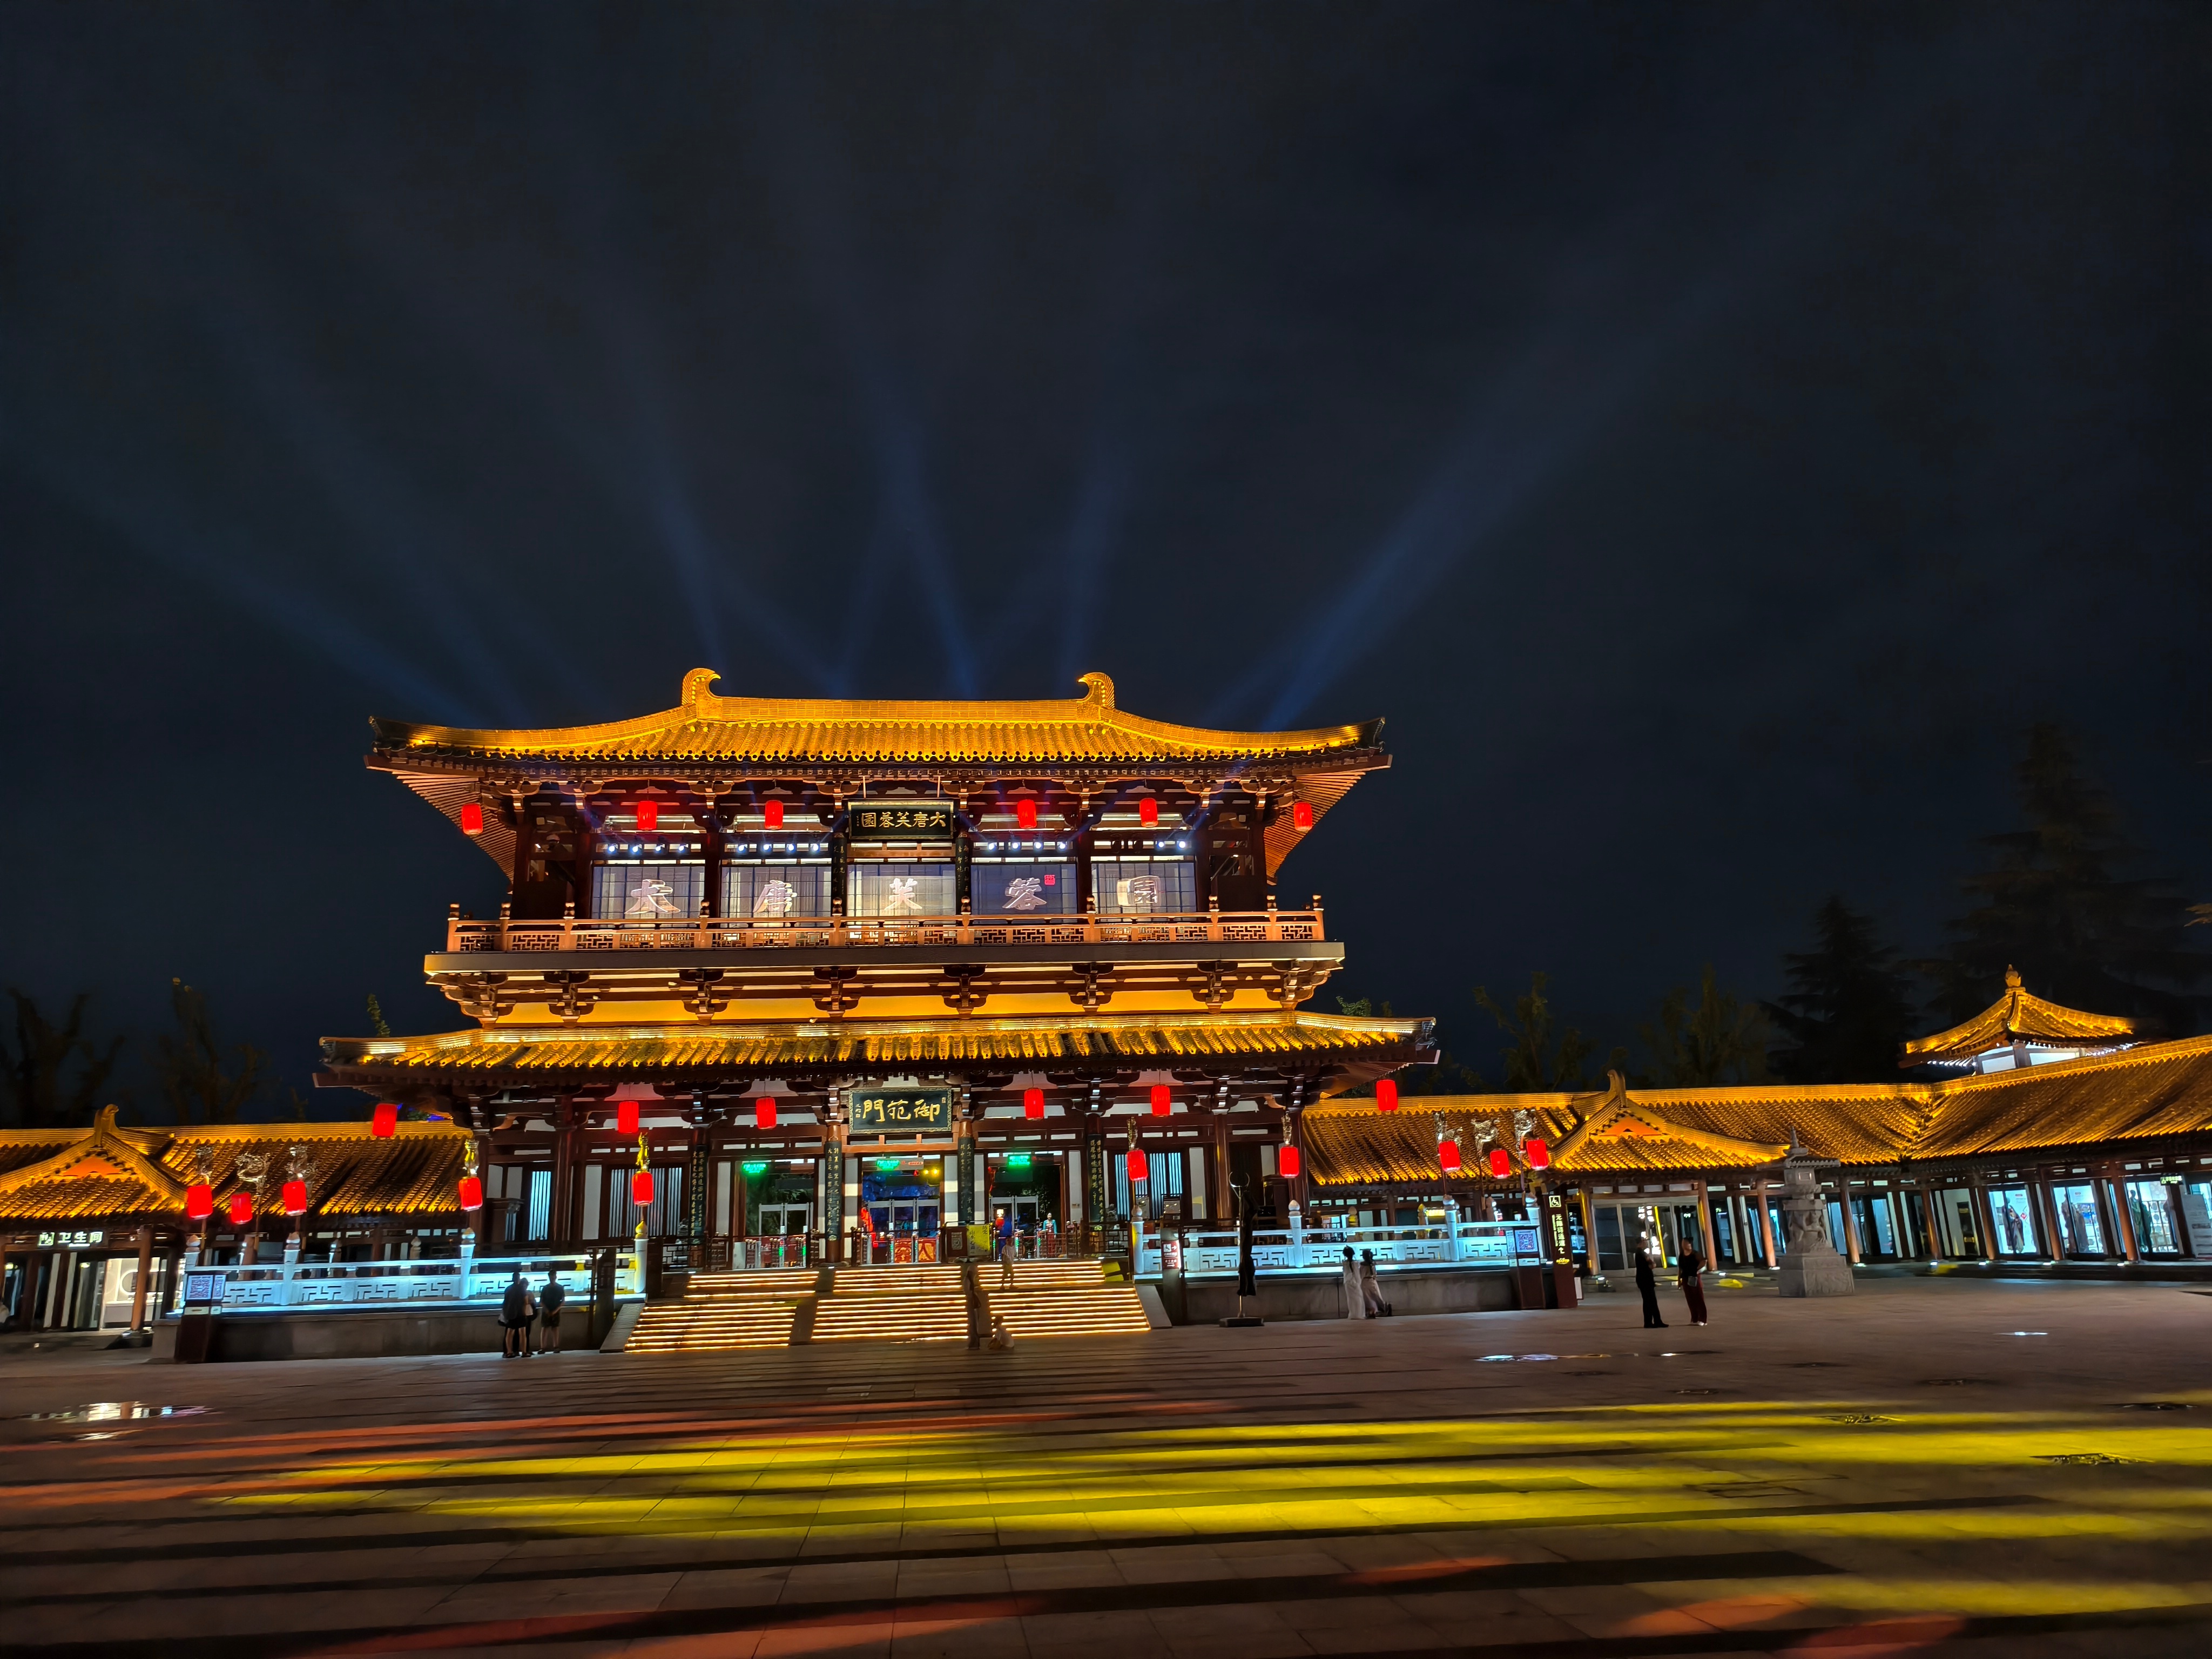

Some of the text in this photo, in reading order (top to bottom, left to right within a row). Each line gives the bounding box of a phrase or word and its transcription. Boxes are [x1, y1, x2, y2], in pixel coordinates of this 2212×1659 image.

[861, 811, 946, 828] 大唐芙蓉園
[624, 879, 681, 914] 大
[753, 880, 797, 913] 唐
[884, 878, 922, 910] 芙
[1002, 877, 1047, 911] 蓉
[862, 1099, 941, 1122] 御苑門
[58, 1231, 103, 1243] 卫生间
